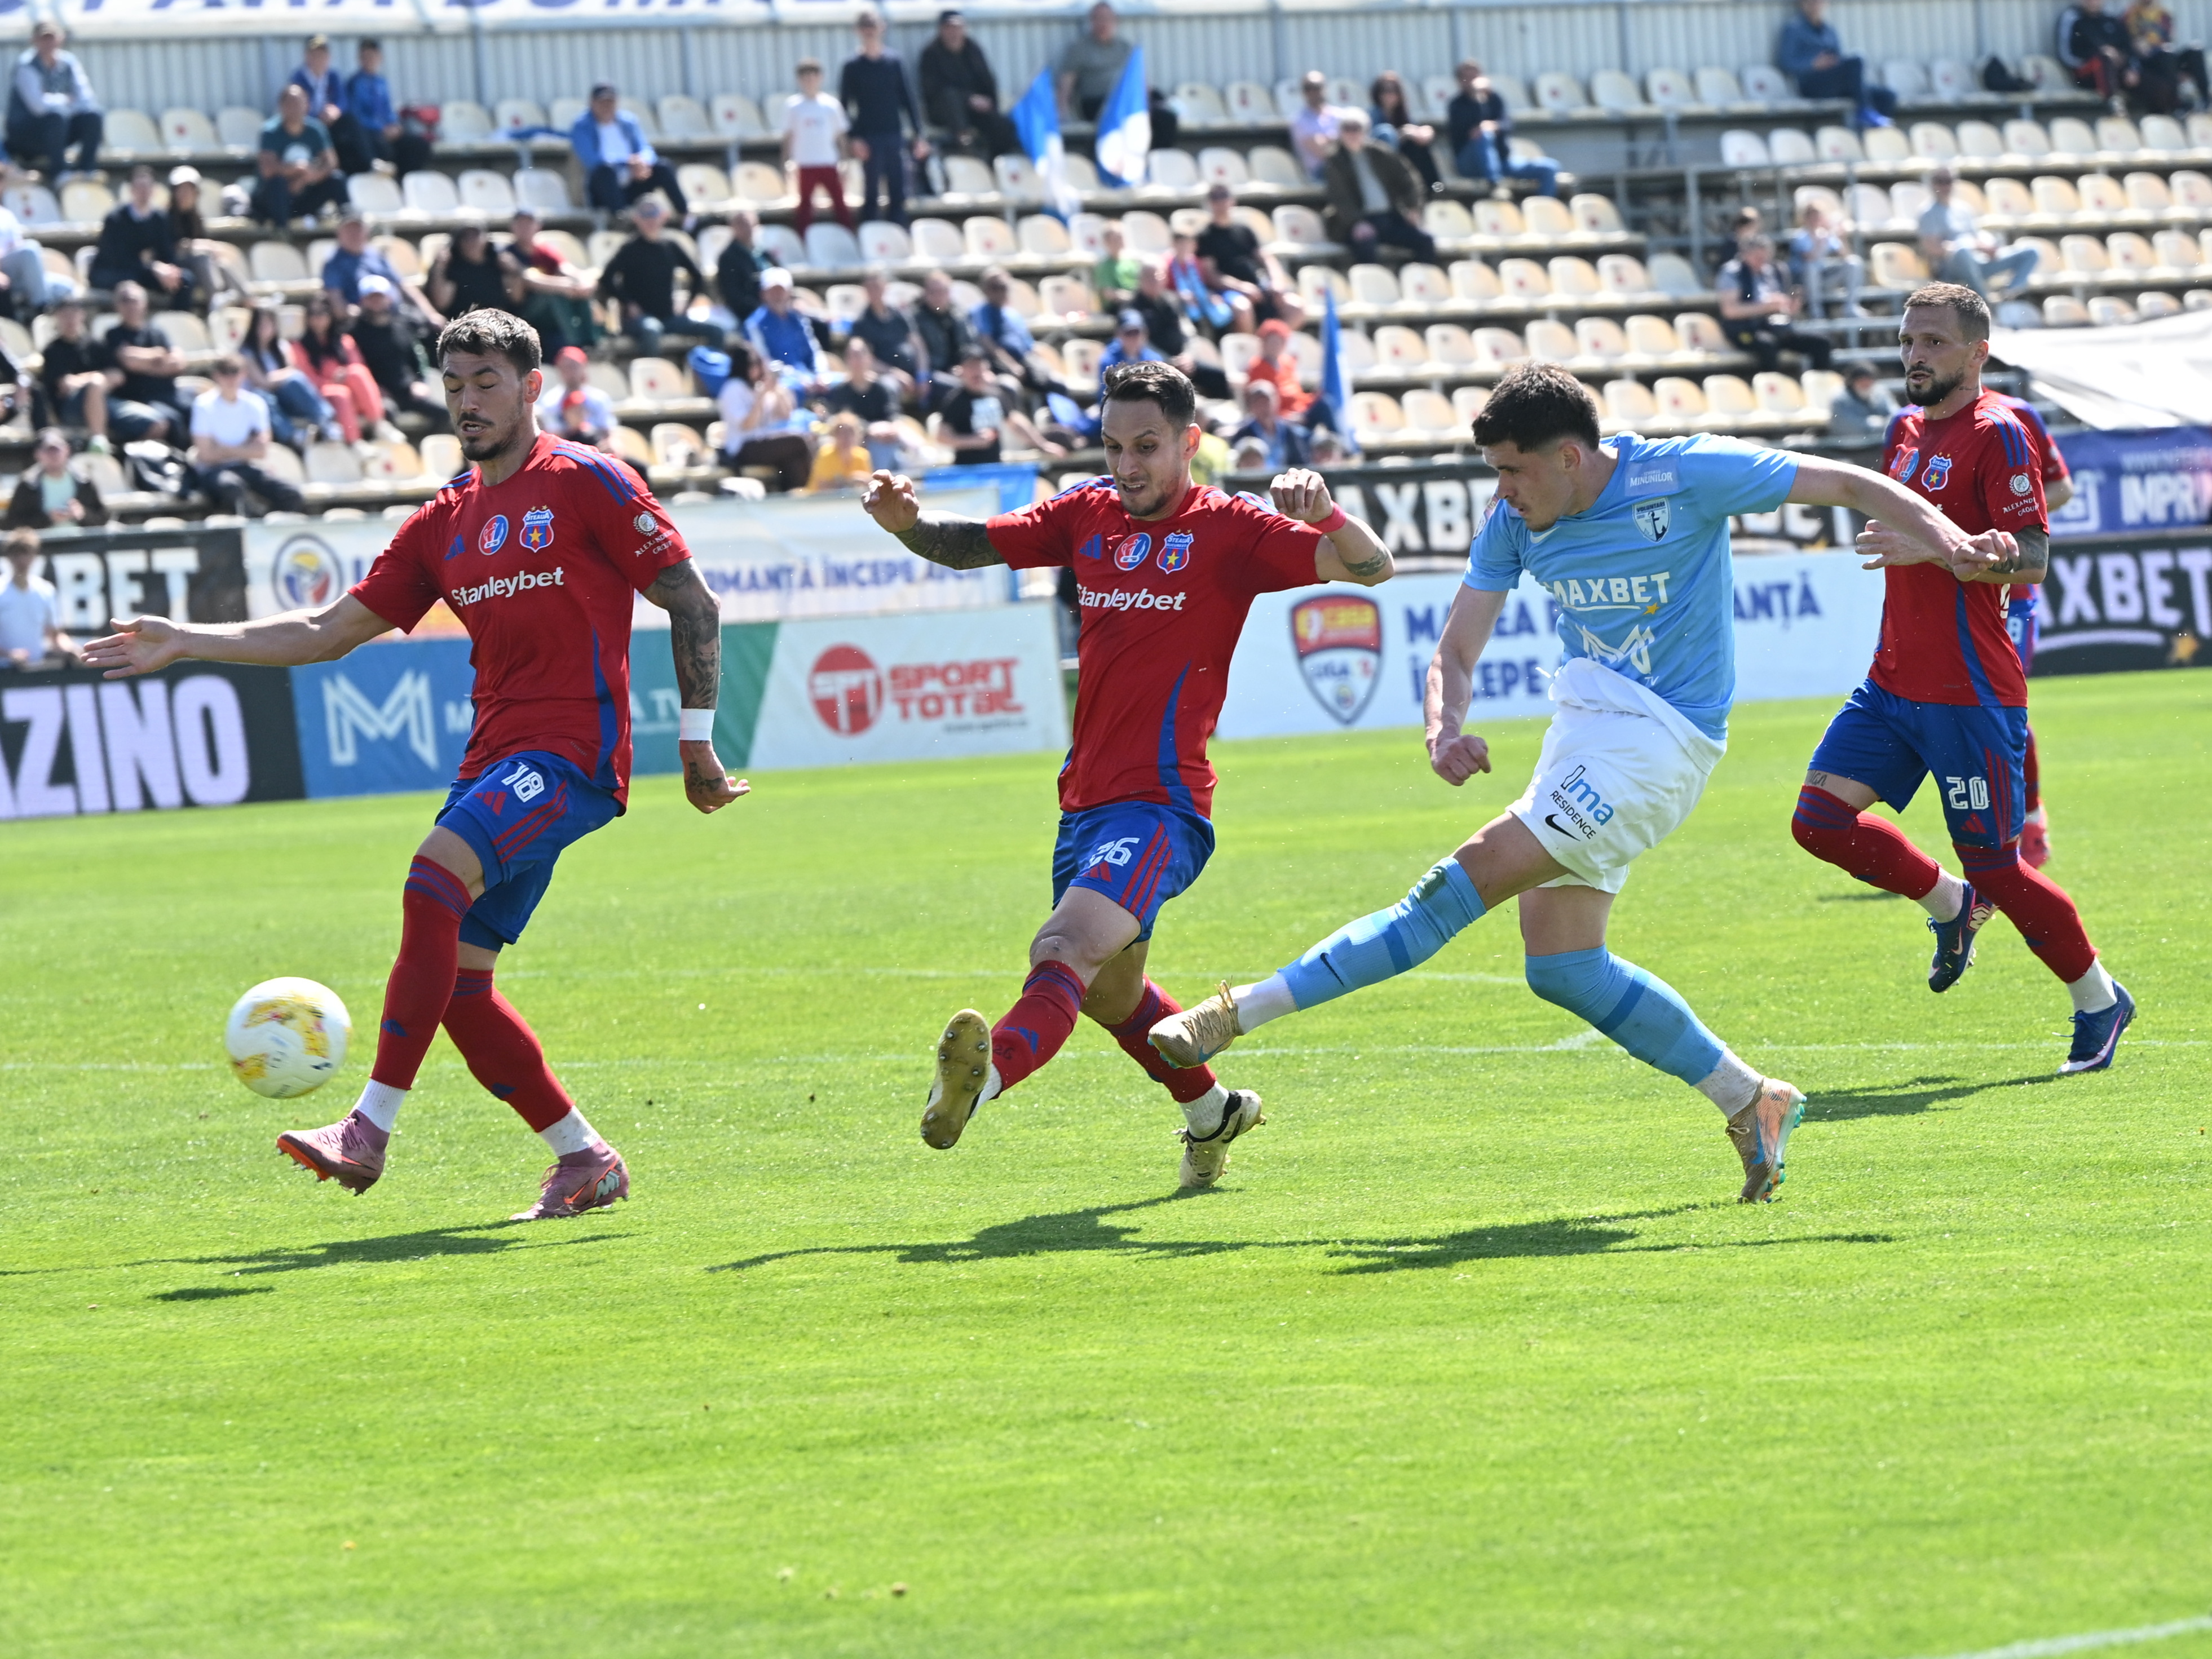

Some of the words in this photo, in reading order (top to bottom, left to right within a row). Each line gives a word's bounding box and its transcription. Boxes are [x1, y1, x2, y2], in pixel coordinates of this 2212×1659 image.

[1630, 472, 1673, 487] MINUNILOR
[526, 512, 550, 521] STEAUA
[1167, 535, 1191, 543] STEAUA
[28, 547, 200, 629] BET
[452, 567, 564, 607] Stanleybet
[1076, 583, 1187, 611] Stanleybet
[2038, 547, 2212, 639] XBET
[889, 657, 1019, 692] SPORT
[501, 762, 545, 803] 18
[1945, 776, 1989, 810] 20
[1549, 790, 1597, 840] RESIDENCE
[1088, 837, 1141, 868] 26
